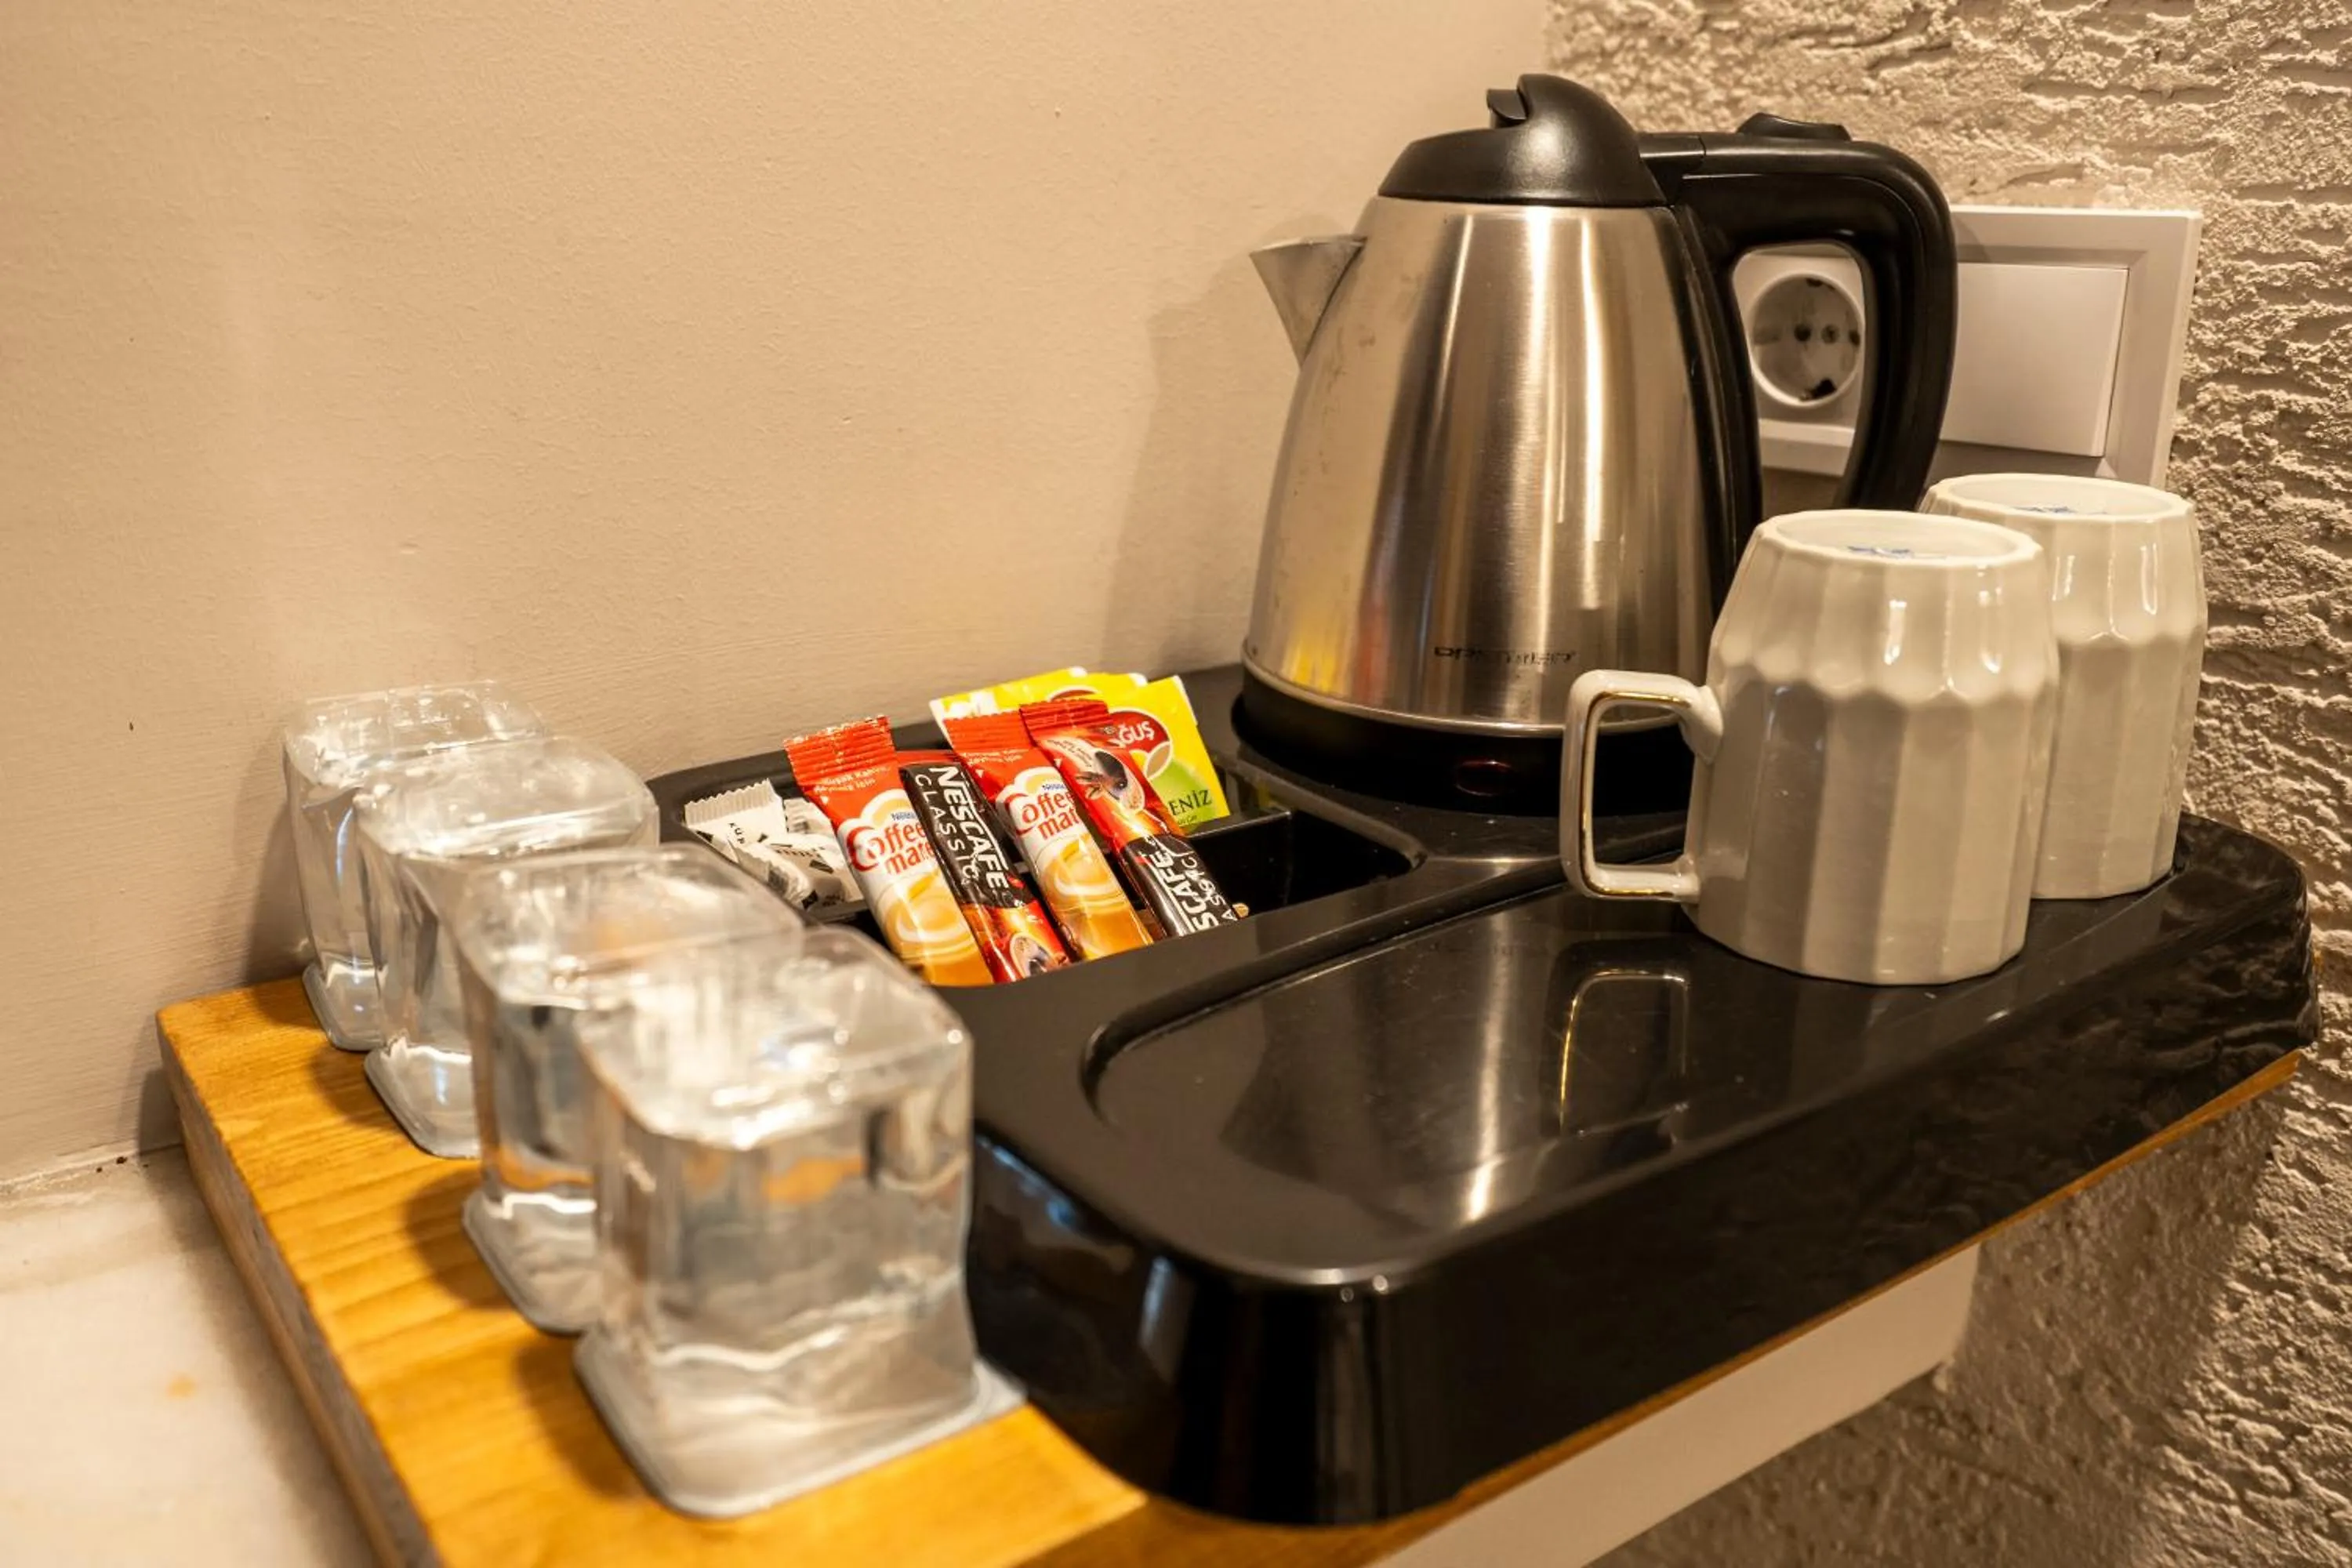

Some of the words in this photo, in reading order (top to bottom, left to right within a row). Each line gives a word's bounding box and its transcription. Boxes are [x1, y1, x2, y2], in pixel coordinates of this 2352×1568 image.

[1112, 720, 1155, 747] ĞUŞ
[1167, 789, 1212, 816] ENİZ
[915, 774, 979, 880] CLASSIC
[847, 823, 926, 872] Coffee
